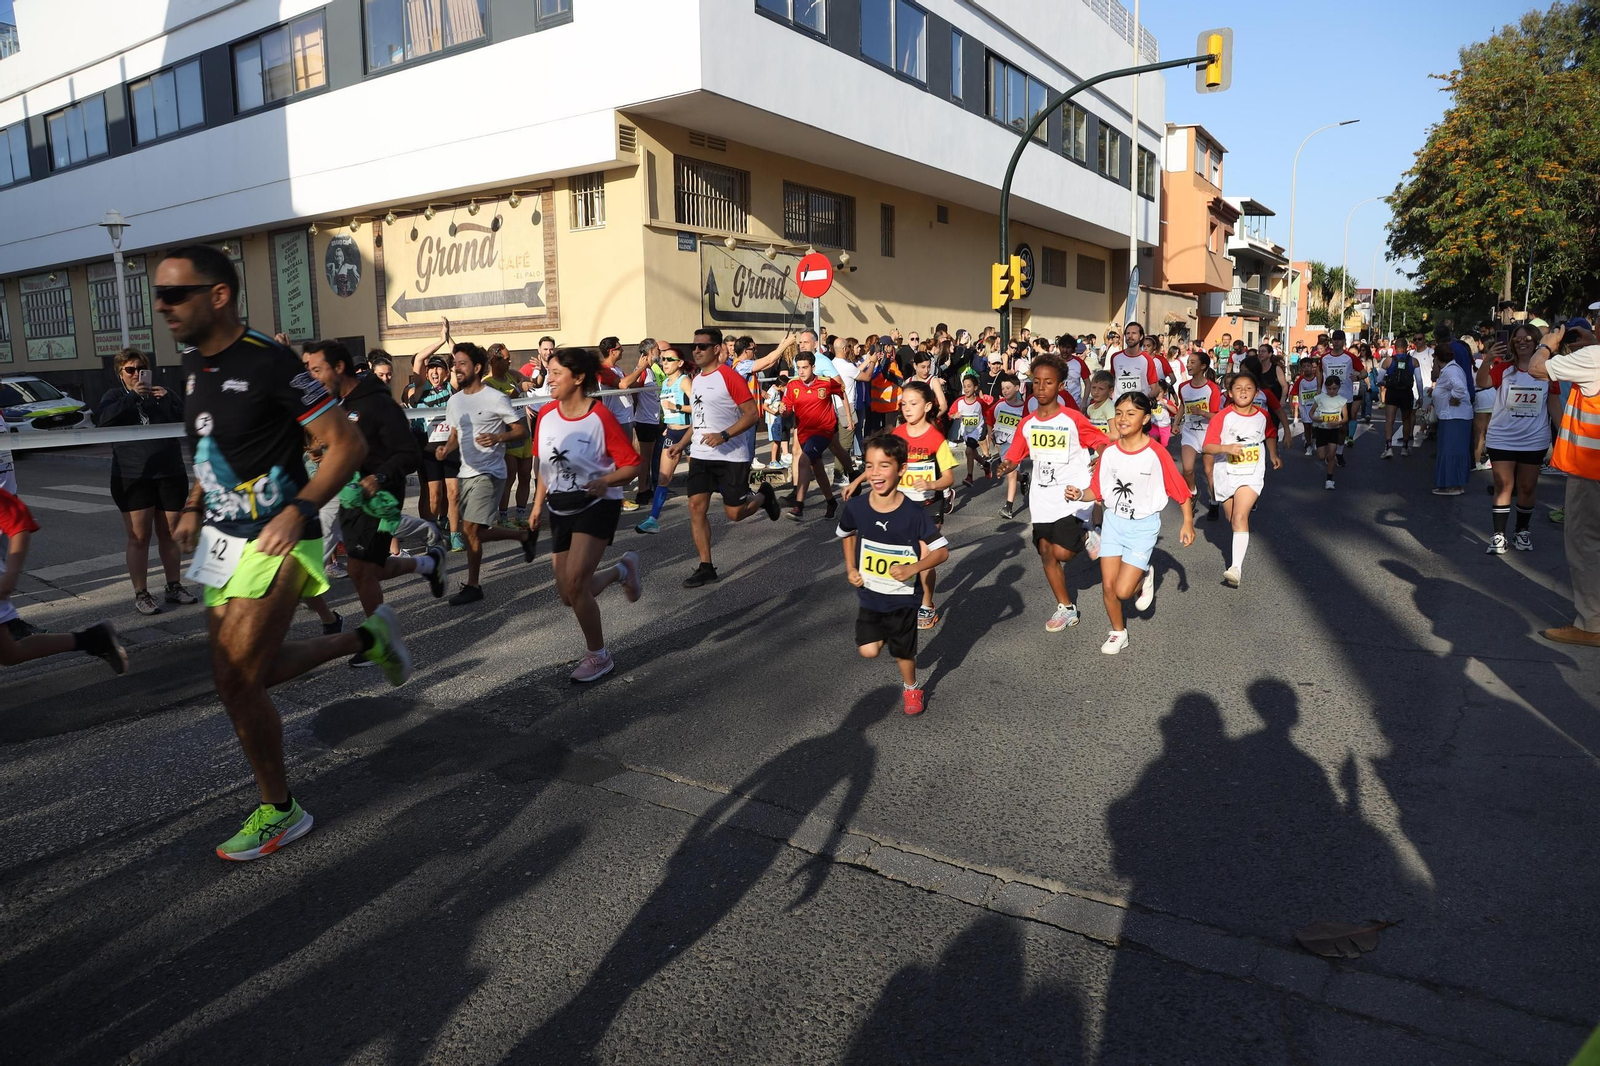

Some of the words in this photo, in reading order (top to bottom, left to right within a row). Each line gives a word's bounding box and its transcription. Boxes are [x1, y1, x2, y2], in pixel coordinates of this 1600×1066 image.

[415, 214, 503, 293] Grand
[498, 251, 531, 270] CAFÉ
[724, 259, 735, 269] LE
[732, 263, 791, 308] Grand
[793, 388, 799, 399] 9
[1515, 393, 1537, 403] 712
[433, 423, 450, 432] 723
[962, 418, 978, 426] 1068
[1032, 433, 1066, 448] 1034
[907, 445, 929, 455] laga
[1230, 449, 1259, 463] 1085
[210, 538, 229, 560] 42
